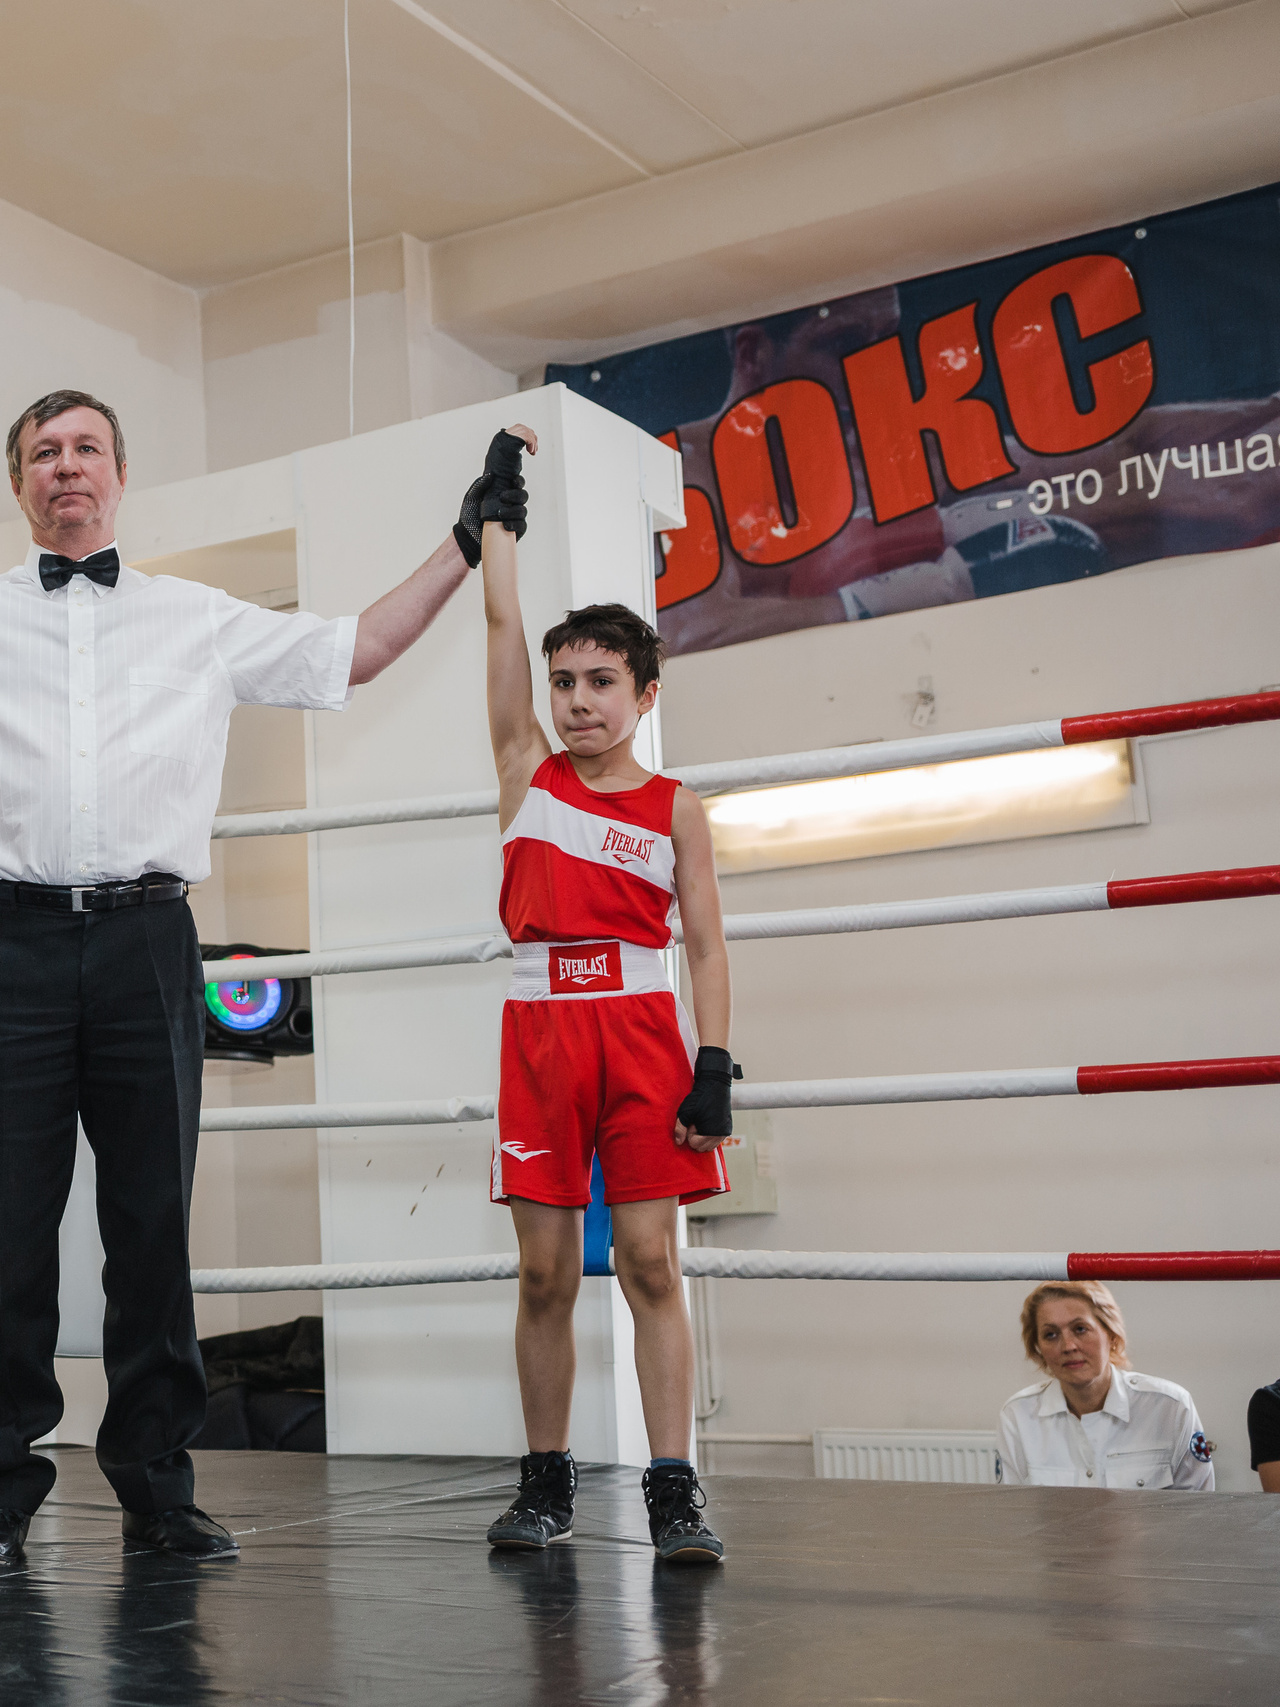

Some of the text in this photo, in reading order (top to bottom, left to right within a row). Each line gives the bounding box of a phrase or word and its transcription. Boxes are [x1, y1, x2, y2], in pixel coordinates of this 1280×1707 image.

[1027, 468, 1103, 516] это
[1118, 433, 1280, 500] лучша
[601, 826, 655, 866] EVERLAST
[558, 953, 611, 981] EVERLAST
